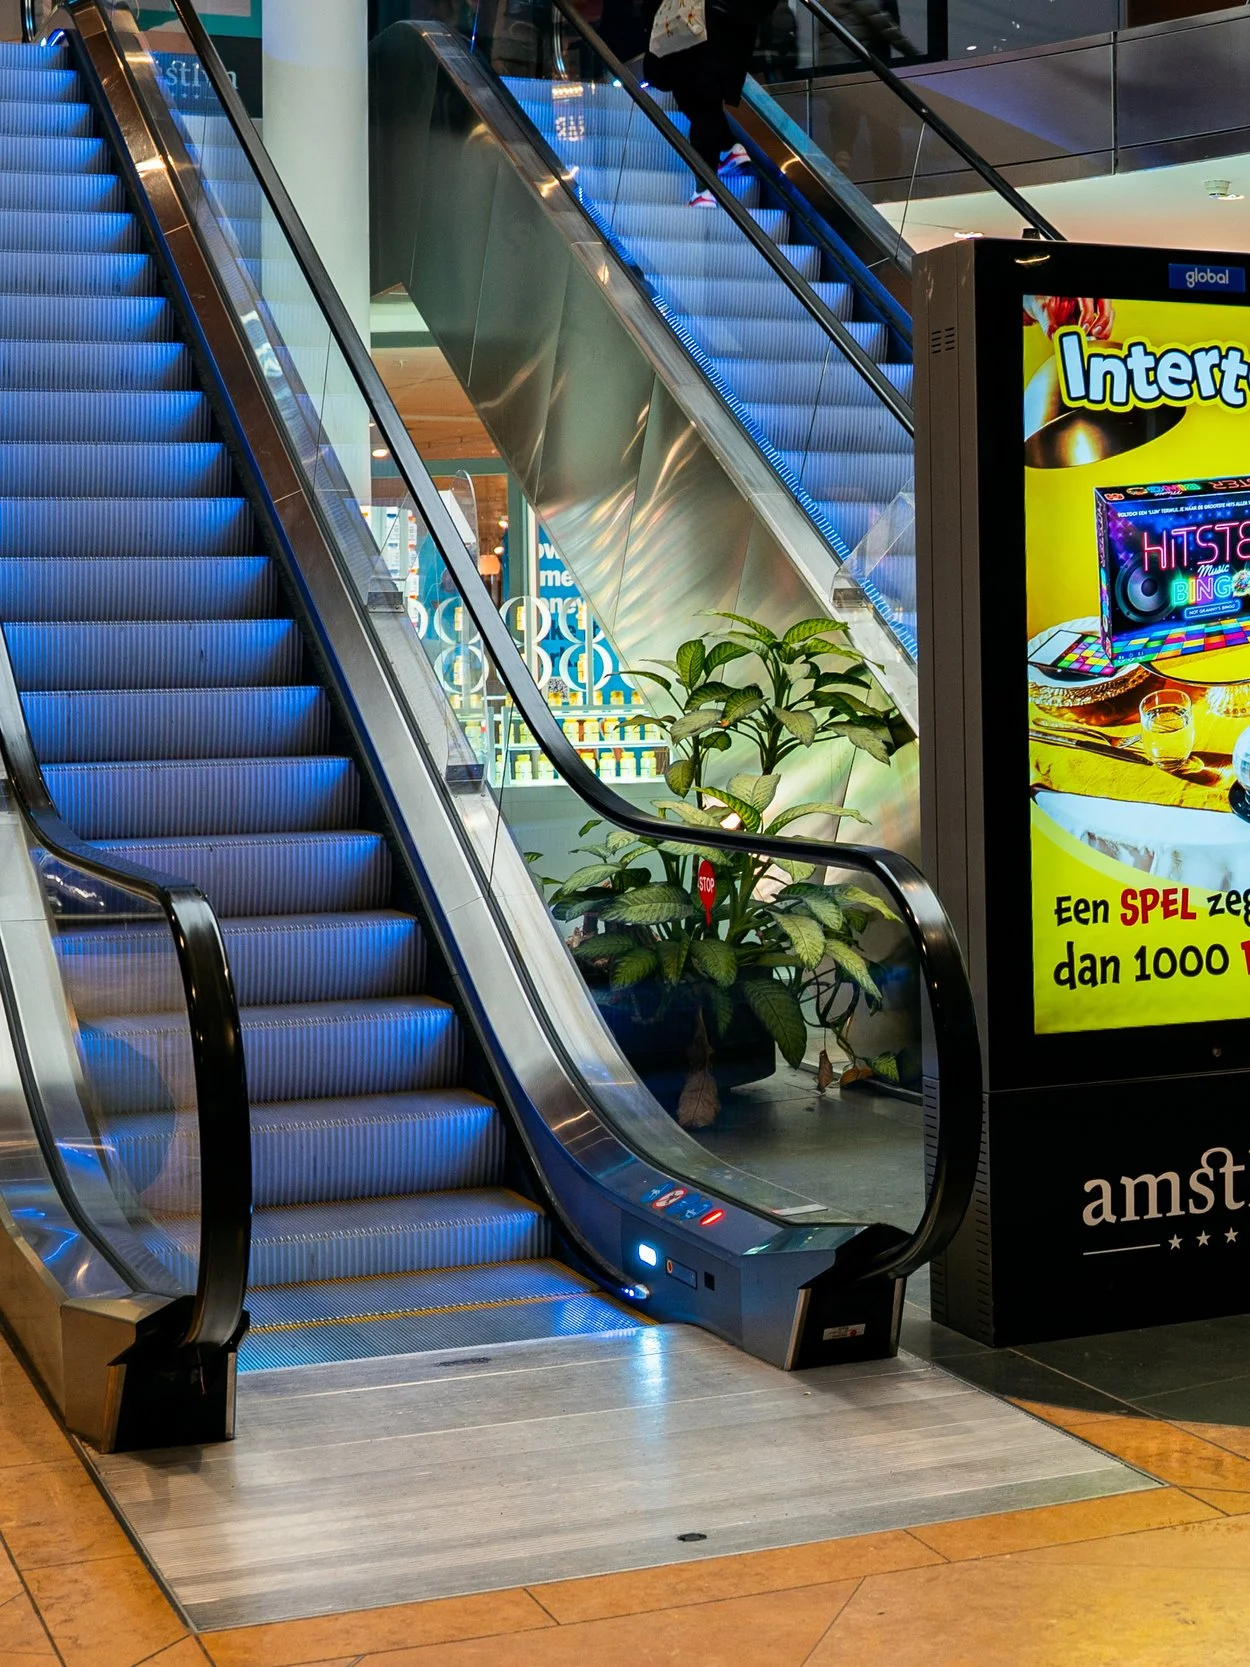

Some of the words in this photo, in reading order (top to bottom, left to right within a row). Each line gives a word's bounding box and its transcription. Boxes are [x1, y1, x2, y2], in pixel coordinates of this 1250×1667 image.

[1185, 267, 1229, 288] global
[1197, 564, 1230, 578] Music
[698, 876, 715, 893] STOP
[1055, 895, 1109, 927] Een
[1120, 888, 1197, 926] SPEL
[1053, 941, 1121, 990] dan
[1133, 943, 1229, 983] 1000
